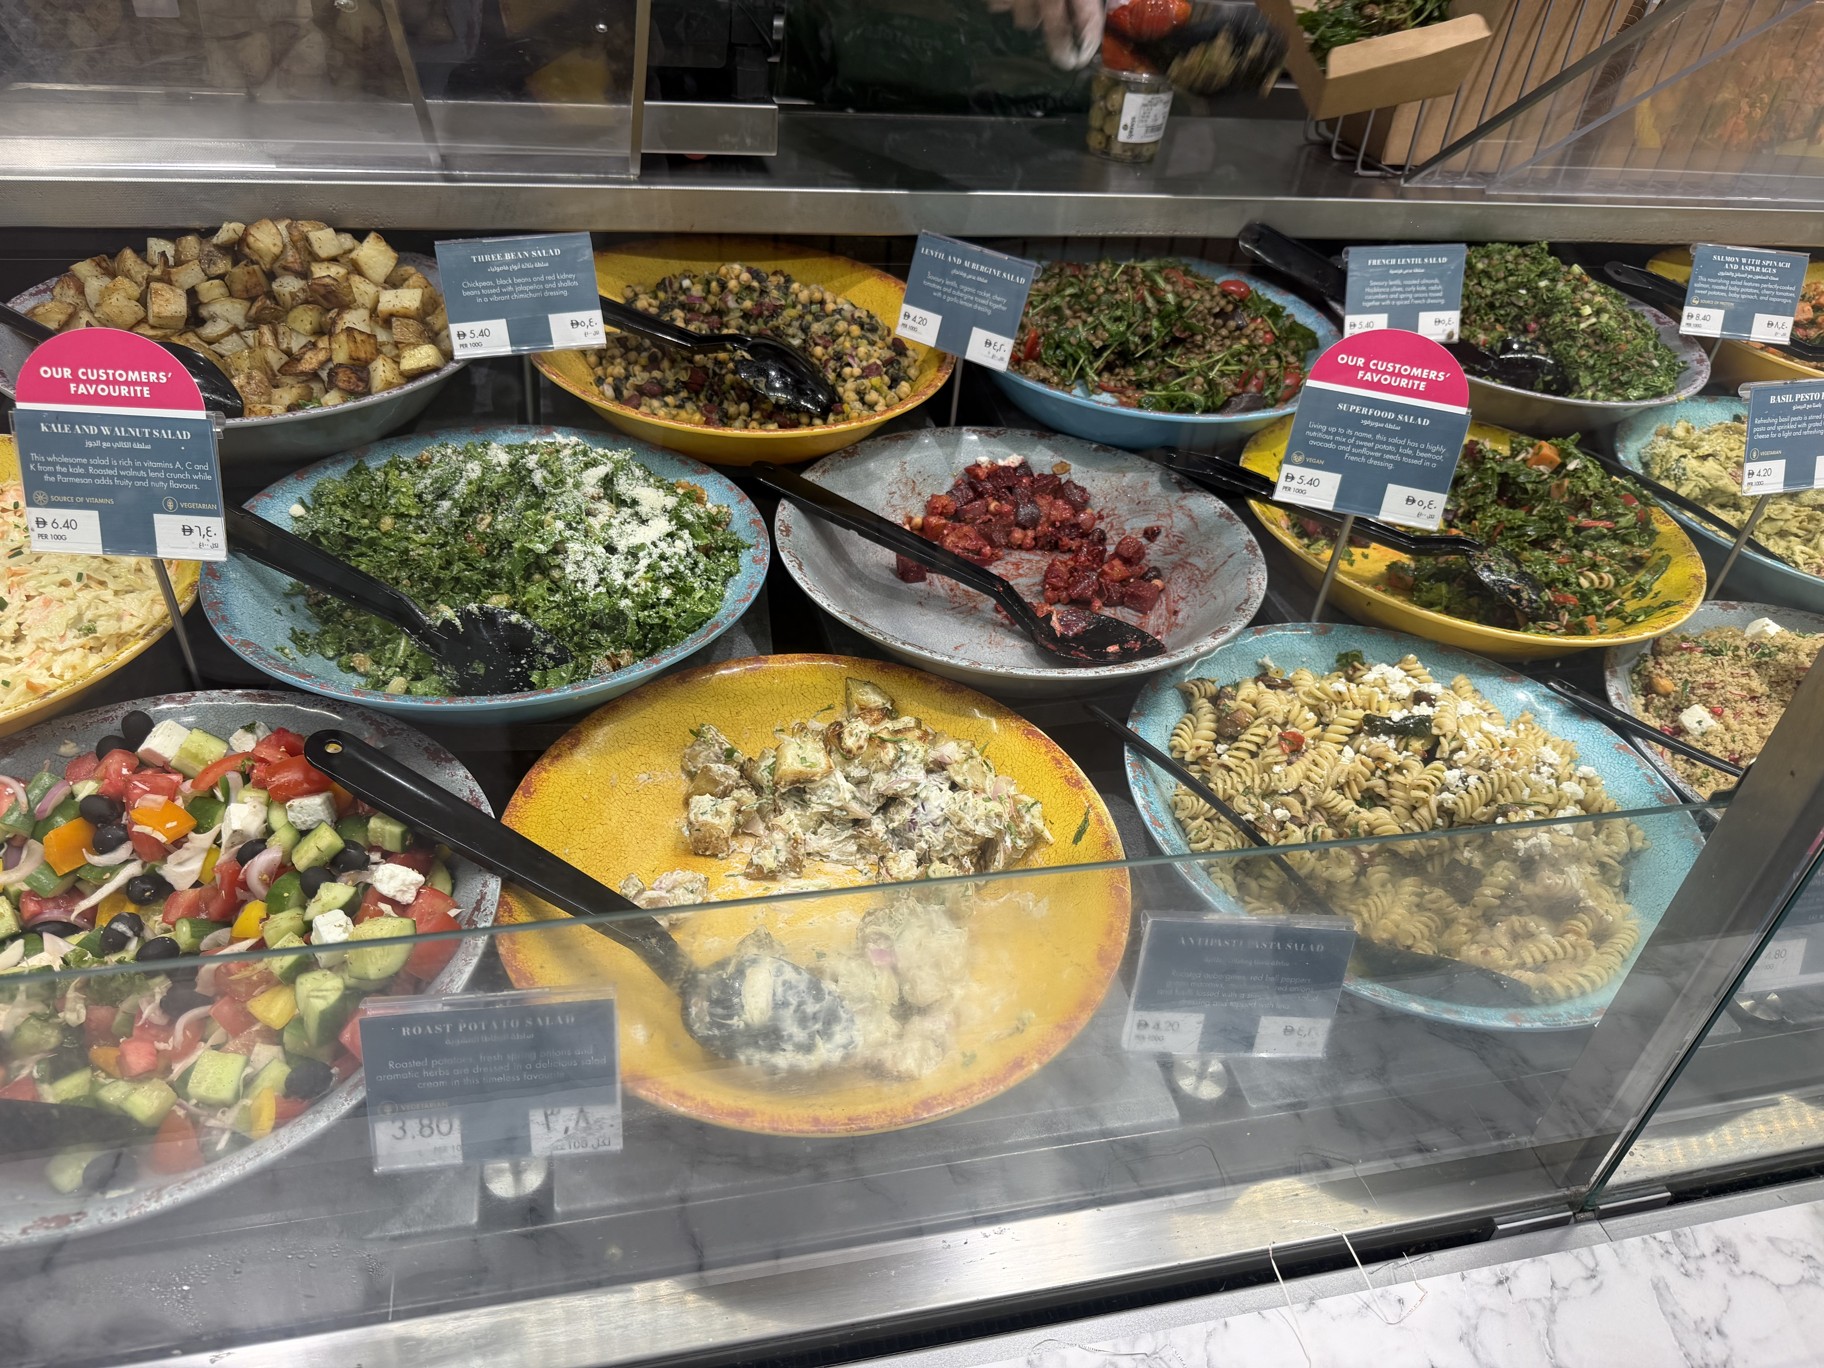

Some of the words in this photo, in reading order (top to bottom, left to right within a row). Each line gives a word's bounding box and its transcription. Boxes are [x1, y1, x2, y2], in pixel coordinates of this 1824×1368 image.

[471, 253, 502, 262] THREE
[503, 251, 529, 260] BEAN
[530, 248, 560, 257] SALAD
[1713, 255, 1740, 263] SALMON
[1761, 260, 1791, 268] SPINACH
[921, 248, 946, 260] LENTIL
[947, 255, 962, 265] AND
[964, 260, 1001, 277] AUBERGINE
[1001, 272, 1026, 284] SALAD
[1739, 265, 1777, 273] ASPARAGUS
[495, 277, 512, 285] black
[556, 272, 575, 282] kidney
[912, 316, 929, 326] 4.20
[1358, 321, 1374, 329] 5.40
[469, 329, 490, 338] 5.40
[40, 368, 73, 379] OUR
[78, 369, 172, 384] CUSTOMERS'
[1338, 355, 1366, 368] OUR
[1369, 360, 1451, 381] CUSTOMERS'
[1357, 371, 1428, 390] FAVOURITE
[70, 384, 151, 397] FAVOURITE
[1770, 394, 1793, 403] BASIL
[1794, 393, 1820, 402] PESTO
[1337, 403, 1395, 420] SUPERFOOD
[1396, 413, 1431, 426] SALAD
[41, 423, 71, 433] KALE
[73, 425, 98, 434] AND
[100, 426, 150, 437] WALNUT
[152, 429, 191, 439] SALAD
[1309, 421, 1327, 433] Living
[1327, 426, 1336, 434] up
[1337, 426, 1344, 434] to
[1353, 431, 1374, 440] name,
[1374, 433, 1387, 441] this
[1387, 435, 1406, 445] salad
[1406, 438, 1419, 447] has
[1425, 442, 1446, 454] highly
[1306, 430, 1333, 441] nutritious
[1334, 434, 1346, 443] mix
[1354, 438, 1374, 448] sweet
[1374, 442, 1397, 454] potato,
[1397, 446, 1414, 456] kale,
[1414, 449, 1445, 462] beetroot,
[1309, 438, 1336, 449] avocado
[1337, 443, 1350, 452] and
[1351, 446, 1382, 457] sunflower
[1382, 451, 1401, 461] seeds
[1401, 455, 1423, 465] tossed
[31, 454, 45, 462] This
[46, 454, 87, 464] wholesome
[88, 457, 109, 465] salad
[118, 458, 133, 466] rich
[134, 459, 141, 467] in
[143, 459, 173, 468] vitamins
[174, 461, 183, 470] A,
[193, 462, 209, 470] and
[1345, 453, 1366, 463] French
[30, 463, 35, 471] K
[37, 464, 54, 472] from
[55, 465, 67, 473] the
[68, 465, 86, 474] kale.
[88, 466, 117, 475] Roasted
[118, 468, 146, 477] walnuts
[148, 469, 164, 478] lend
[165, 470, 190, 479] crunch
[192, 472, 212, 480] while
[44, 474, 55, 482] the
[56, 475, 92, 484] Parmesan
[94, 477, 112, 485] adds
[114, 478, 132, 488] fruity
[134, 479, 148, 487] and
[150, 479, 167, 490] nutty
[1297, 476, 1320, 487] 5.40
[51, 518, 78, 530] 6.40
[1248, 939, 1282, 950] ASTA
[402, 1024, 454, 1036] ROAST
[456, 1019, 520, 1032] POTATO
[522, 1015, 575, 1027] SALAD
[391, 1117, 453, 1140] 3.80
